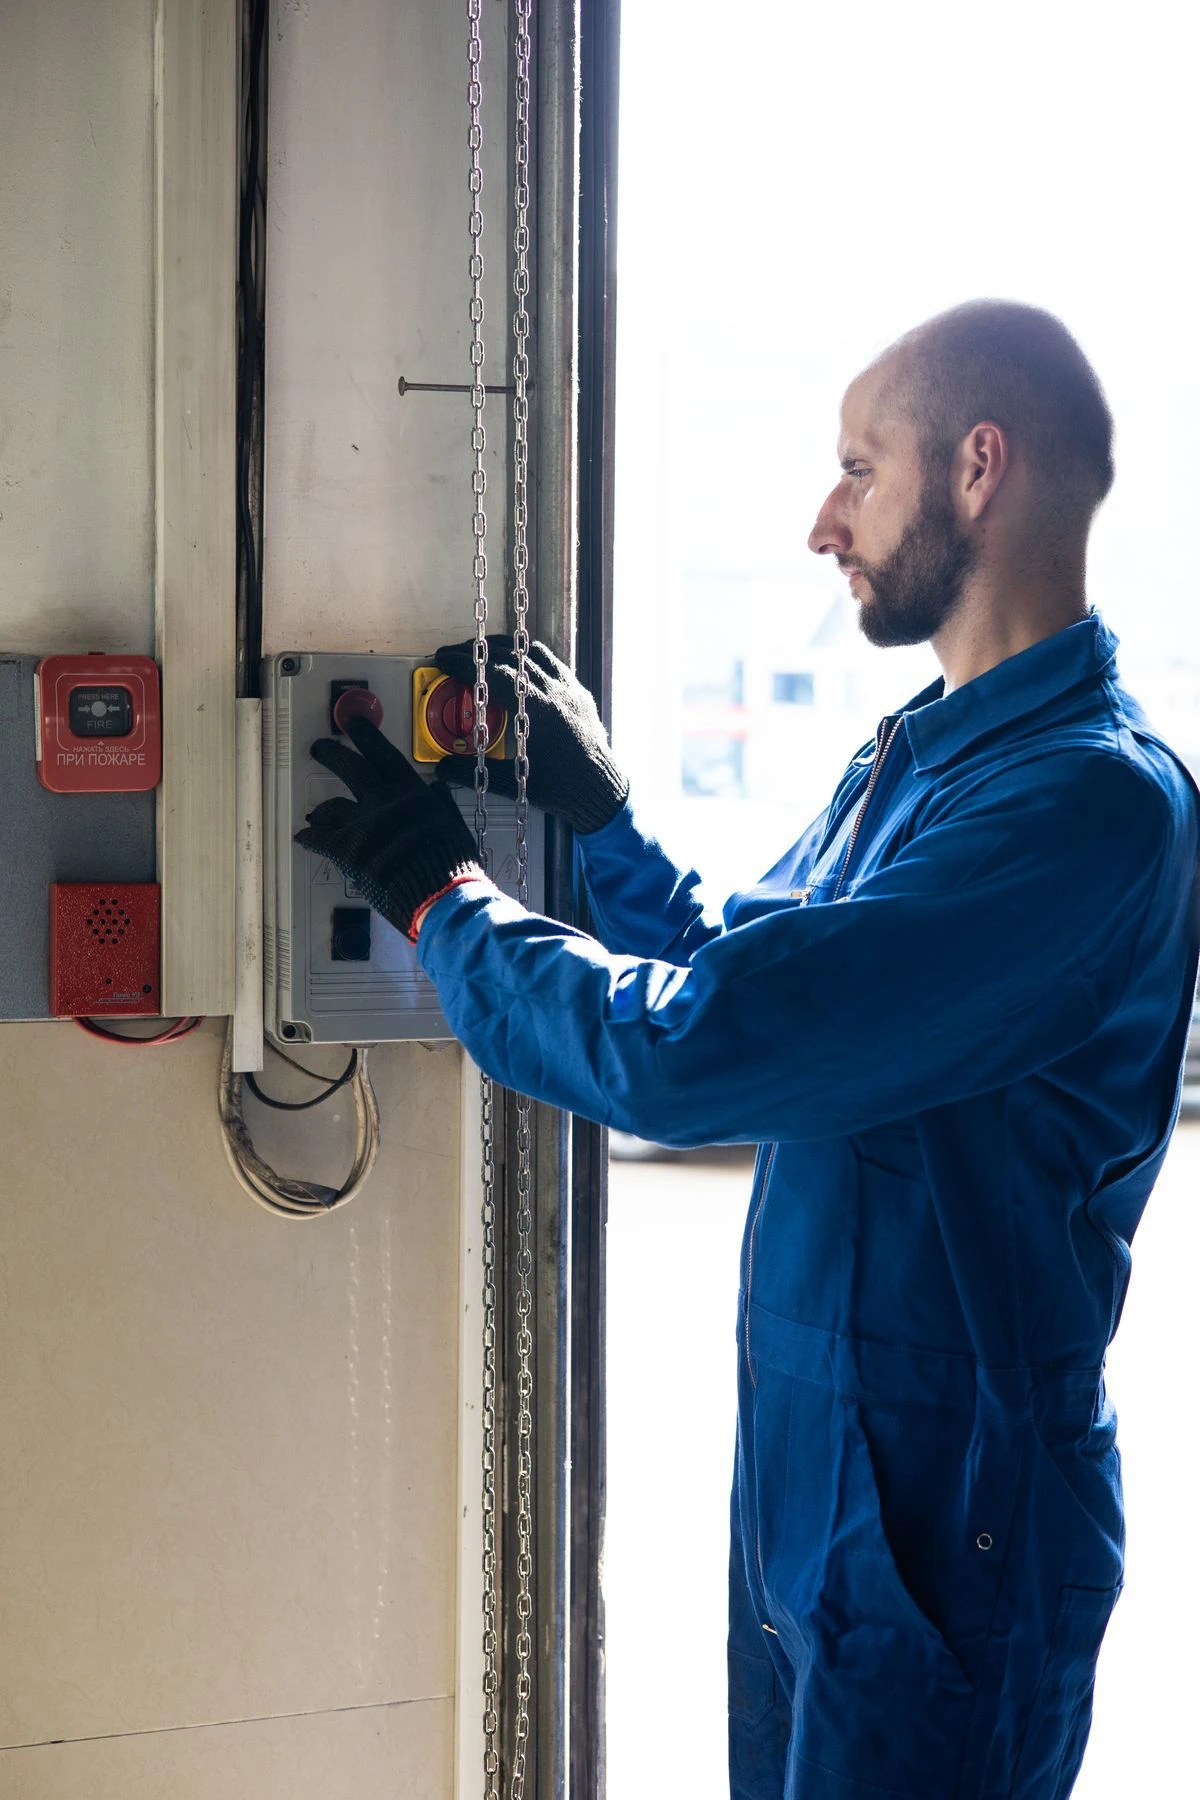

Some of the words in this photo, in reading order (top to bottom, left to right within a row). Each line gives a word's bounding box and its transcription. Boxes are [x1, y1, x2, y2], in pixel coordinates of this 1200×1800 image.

[87, 720, 113, 729] FIRE
[73, 745, 103, 753] НАЖАТЬ
[105, 745, 130, 753] ЗДЕСЬ
[57, 753, 84, 766] ПРИ
[88, 753, 146, 766] ПОЖАРЕ
